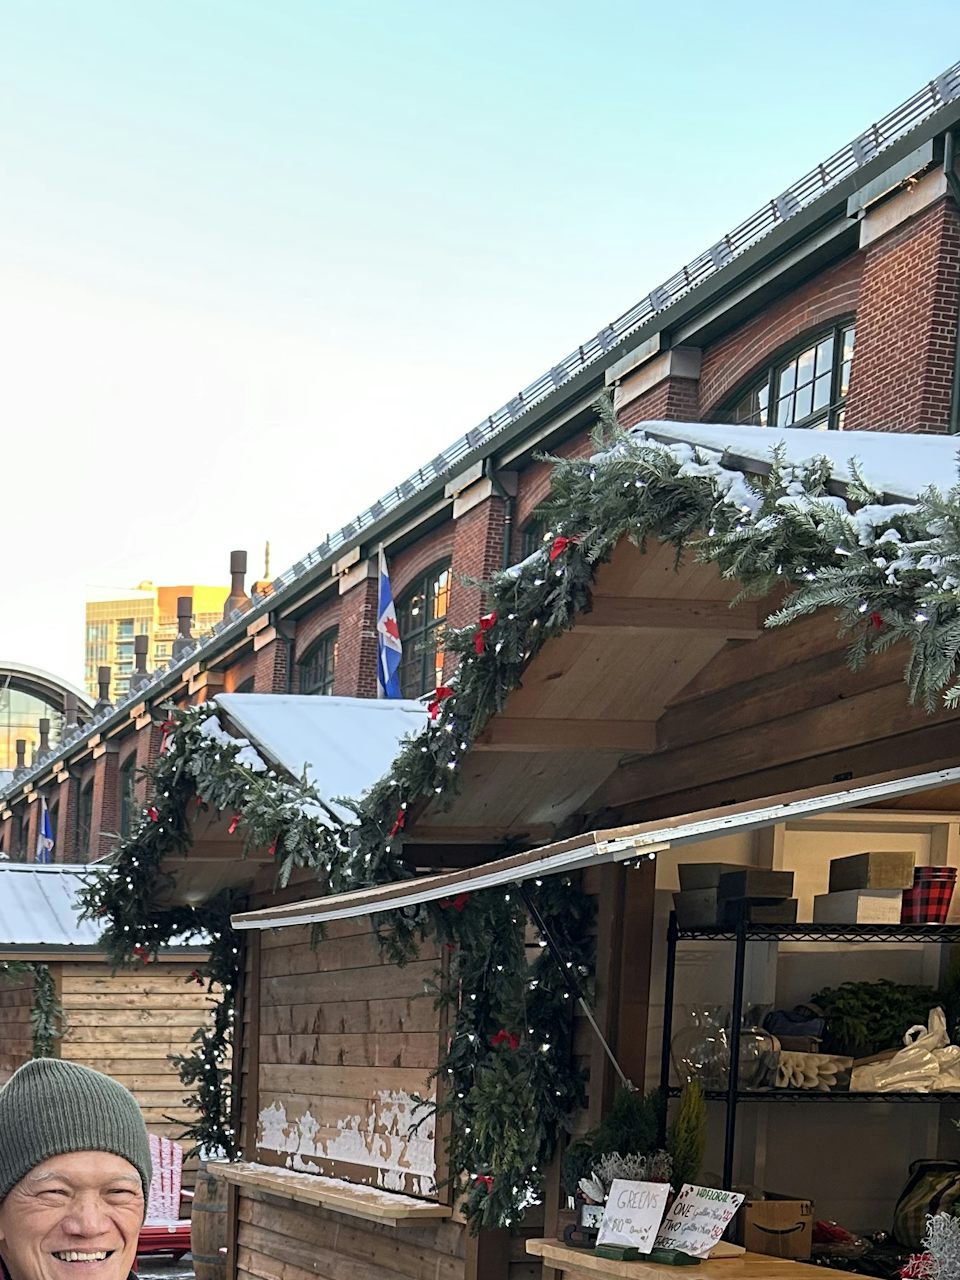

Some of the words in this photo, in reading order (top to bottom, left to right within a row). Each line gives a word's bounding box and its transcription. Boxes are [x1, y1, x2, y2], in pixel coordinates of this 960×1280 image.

[617, 1189, 660, 1210] GREENS
[673, 1202, 695, 1218] ONE
[664, 1218, 682, 1232] TWO
